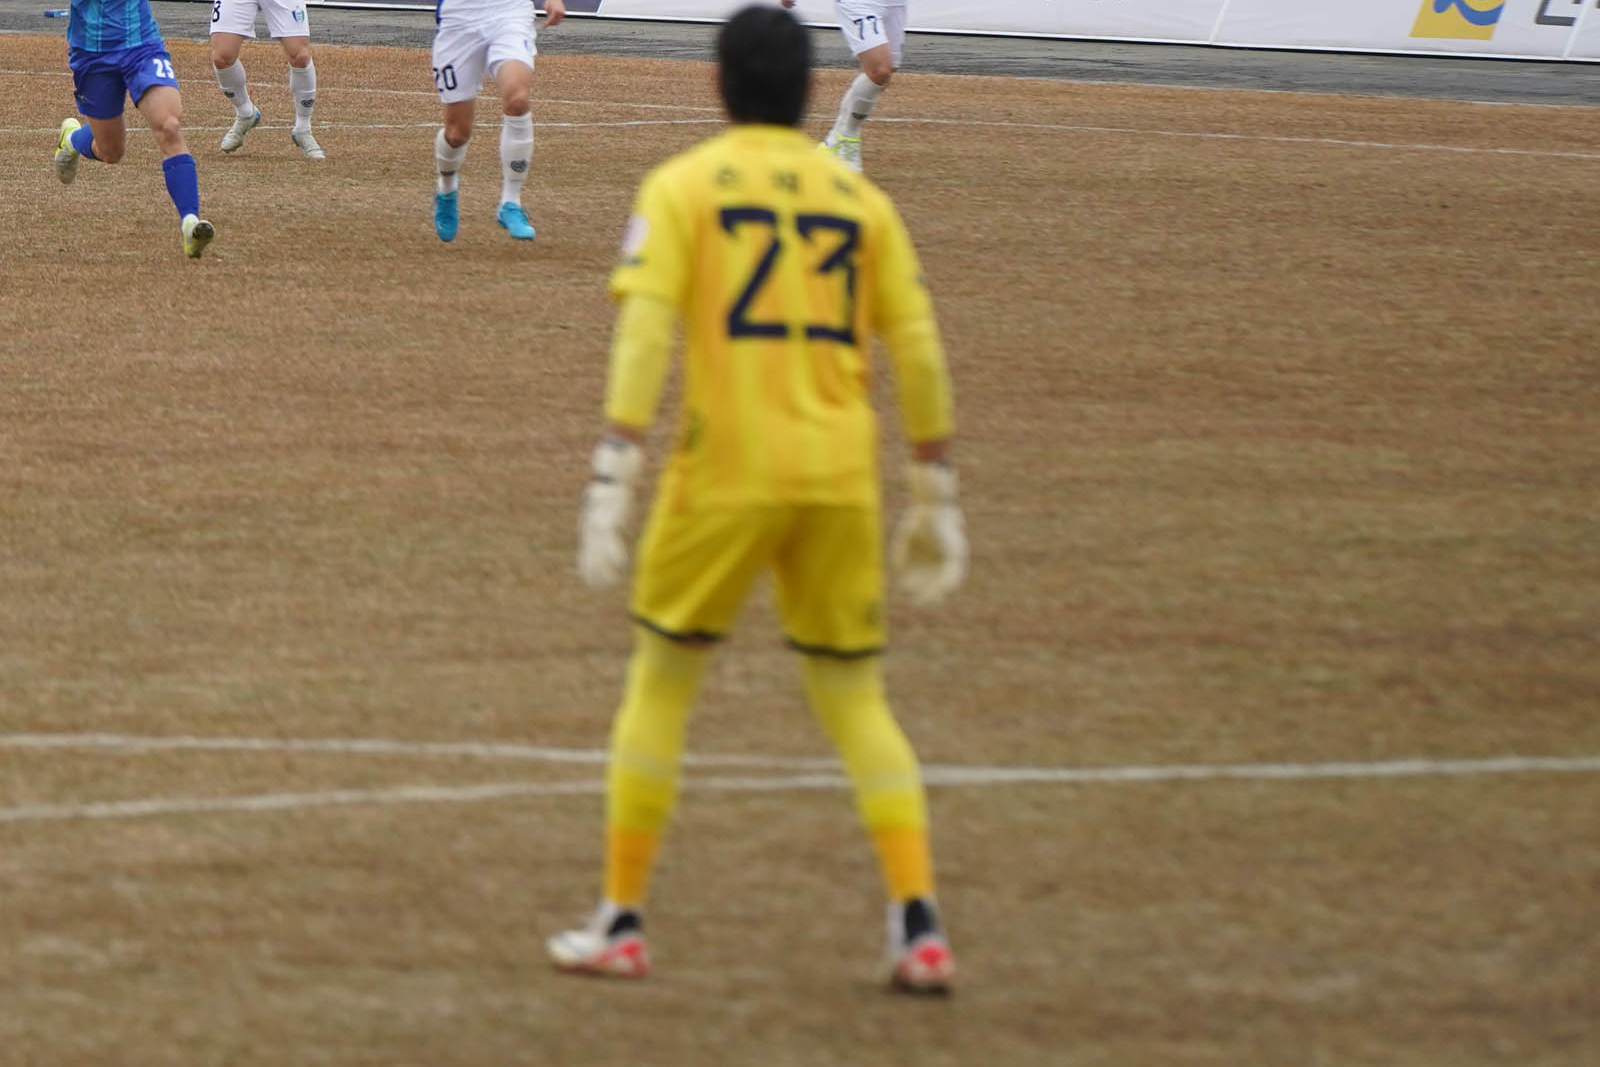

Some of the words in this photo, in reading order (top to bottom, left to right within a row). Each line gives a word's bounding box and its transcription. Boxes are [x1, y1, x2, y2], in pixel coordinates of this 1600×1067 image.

[853, 15, 879, 40] 77
[153, 58, 175, 79] 25
[719, 206, 862, 346] 23
